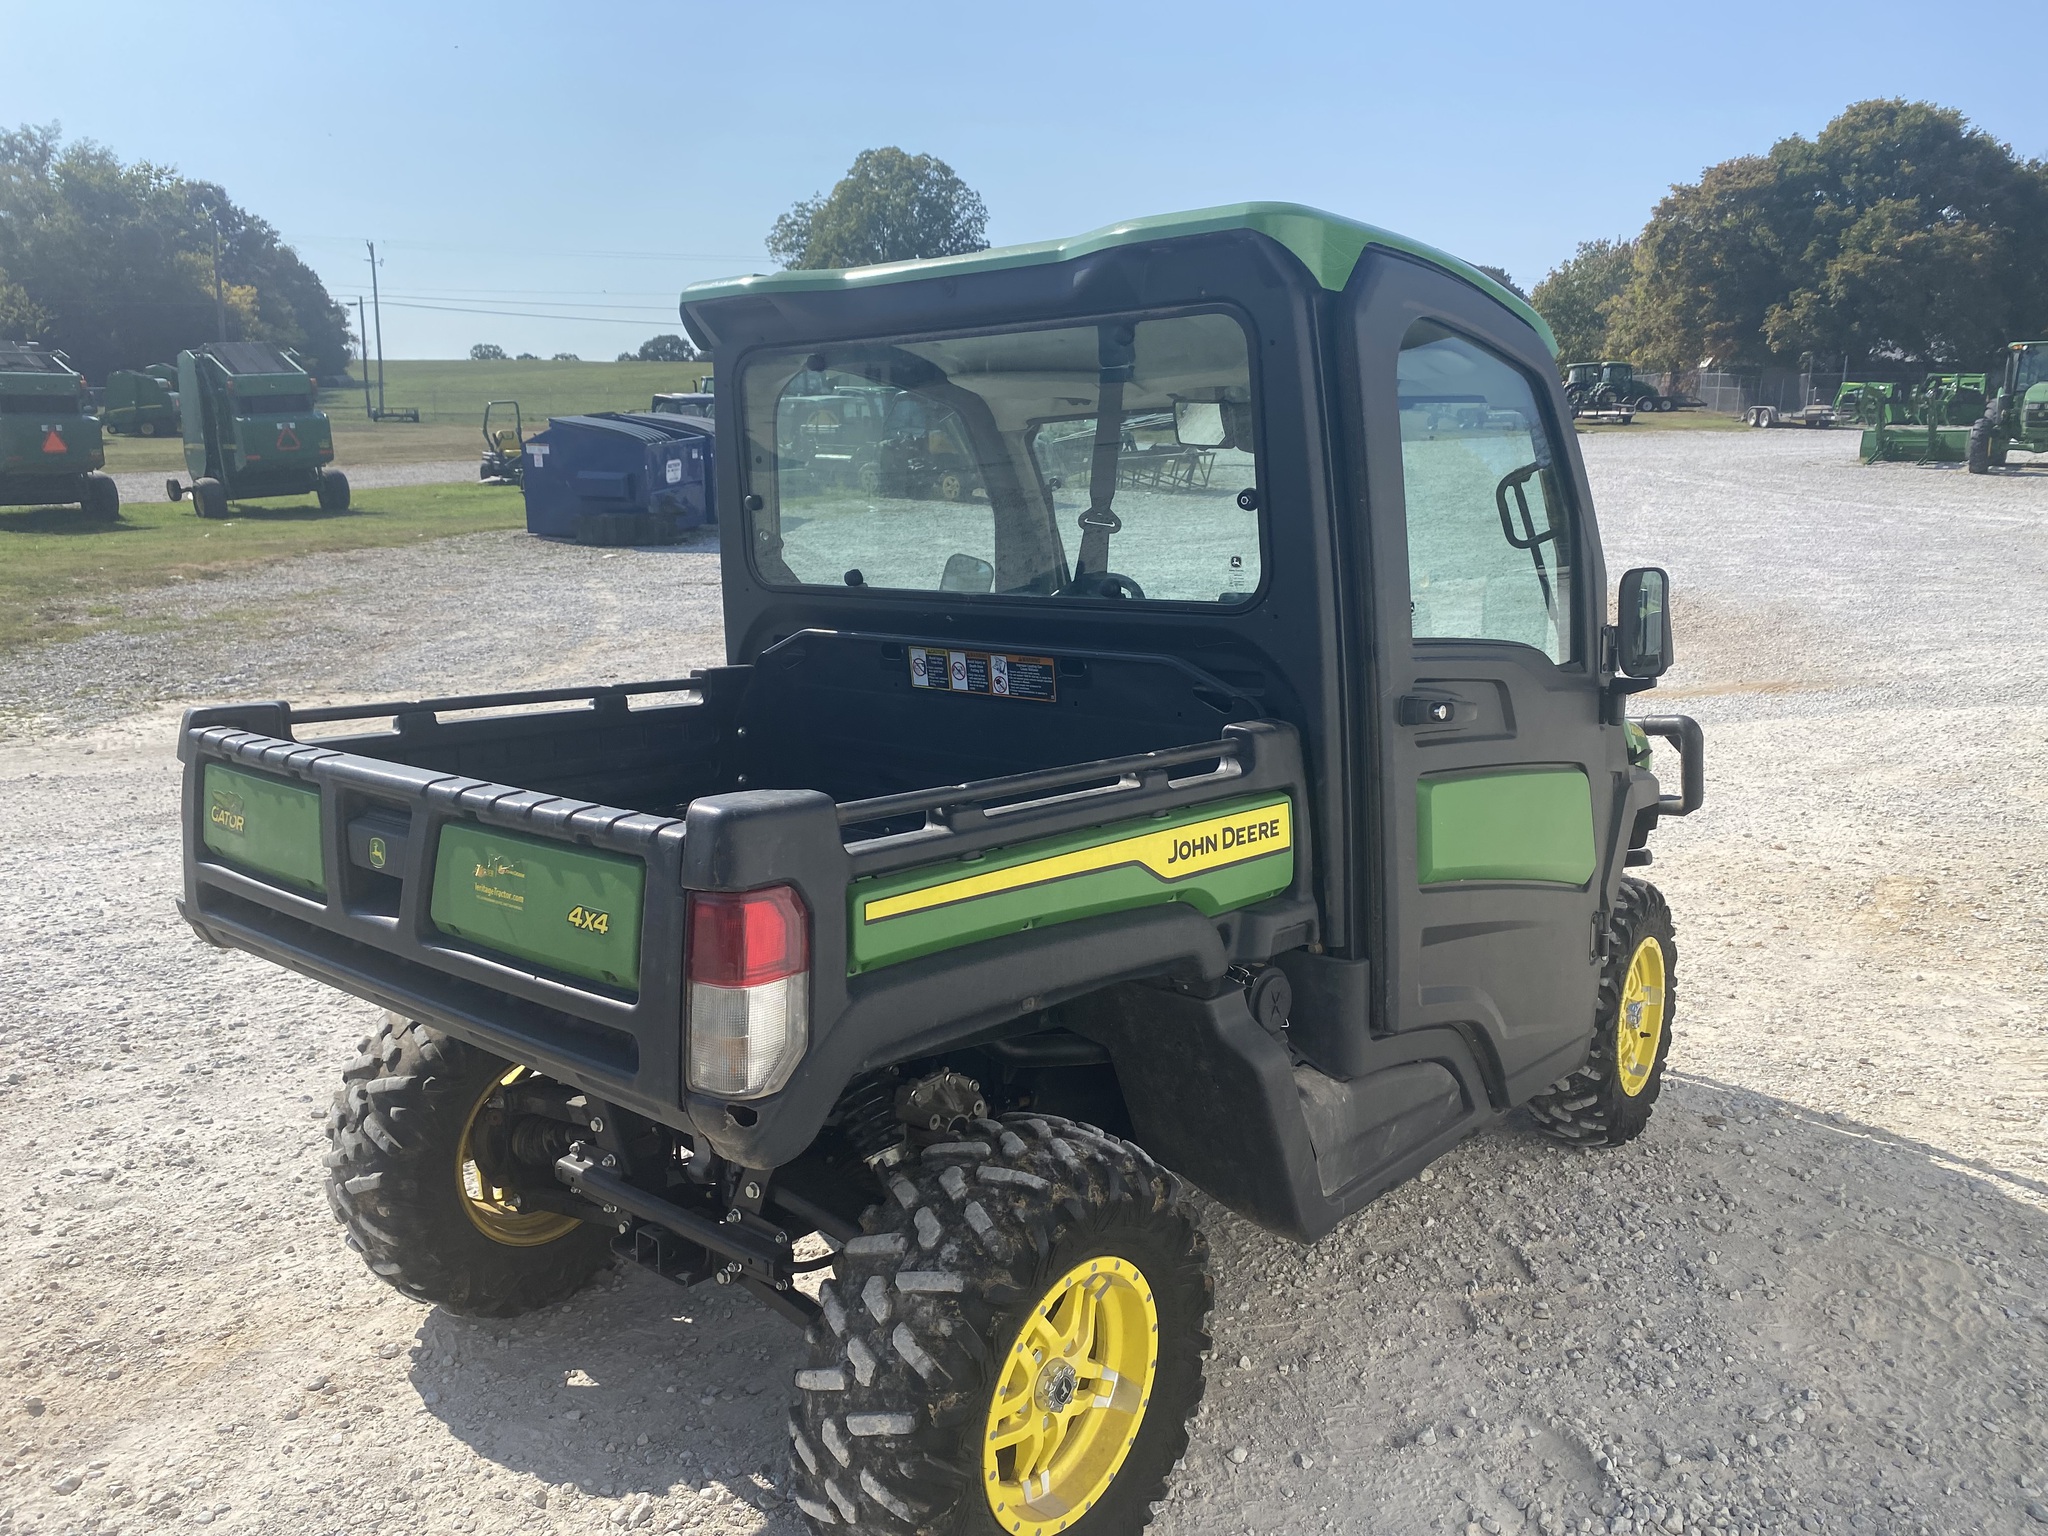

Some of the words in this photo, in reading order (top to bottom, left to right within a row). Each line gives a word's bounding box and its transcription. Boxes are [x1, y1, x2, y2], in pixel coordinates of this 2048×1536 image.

[211, 805, 244, 832] GATOR
[1168, 834, 1217, 864] JOHN
[1222, 819, 1280, 850] DEERE
